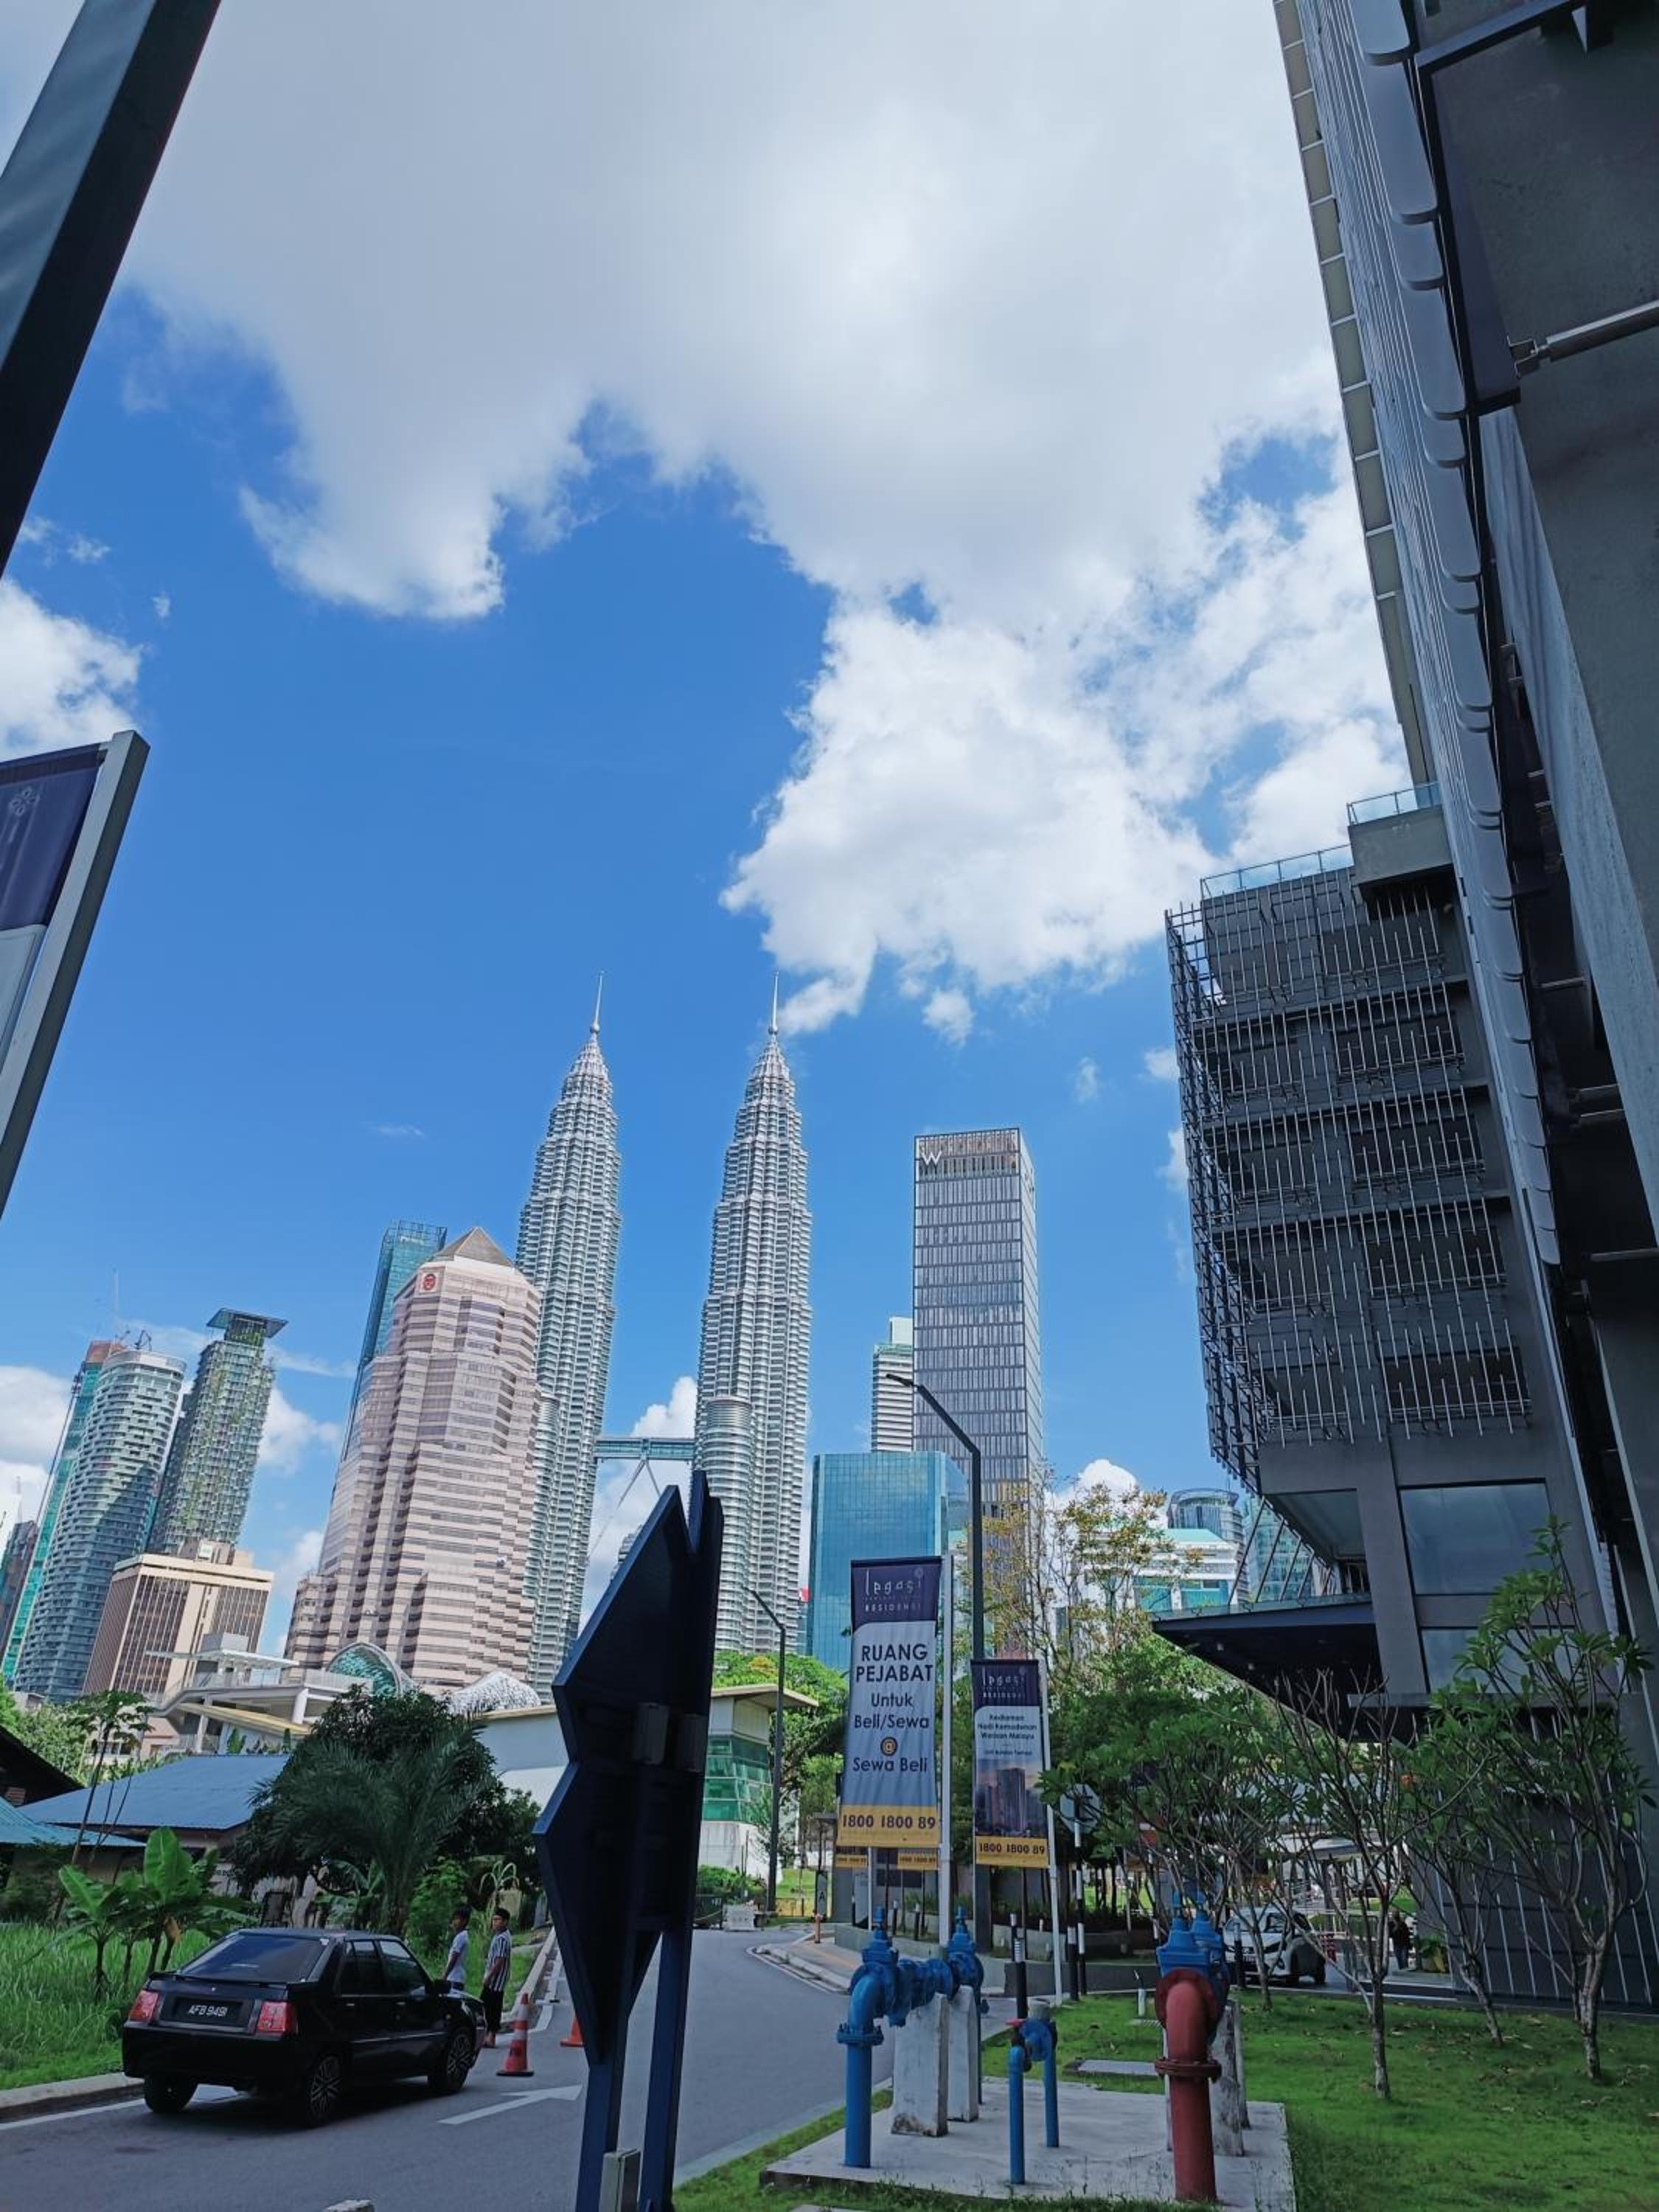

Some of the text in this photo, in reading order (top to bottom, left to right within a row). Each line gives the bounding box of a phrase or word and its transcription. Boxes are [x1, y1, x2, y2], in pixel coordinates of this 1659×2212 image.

[921, 1150, 942, 1166] W
[861, 1643, 928, 1662] RUANG
[856, 1664, 933, 1683] PEJABAT
[871, 1692, 913, 1707] Untuk
[855, 1714, 929, 1731] Beli/Sewa
[852, 1757, 927, 1772] Sewa Beli
[843, 1815, 936, 1829] 1800 1800 89
[979, 1843, 1045, 1854] 1800 1800 89
